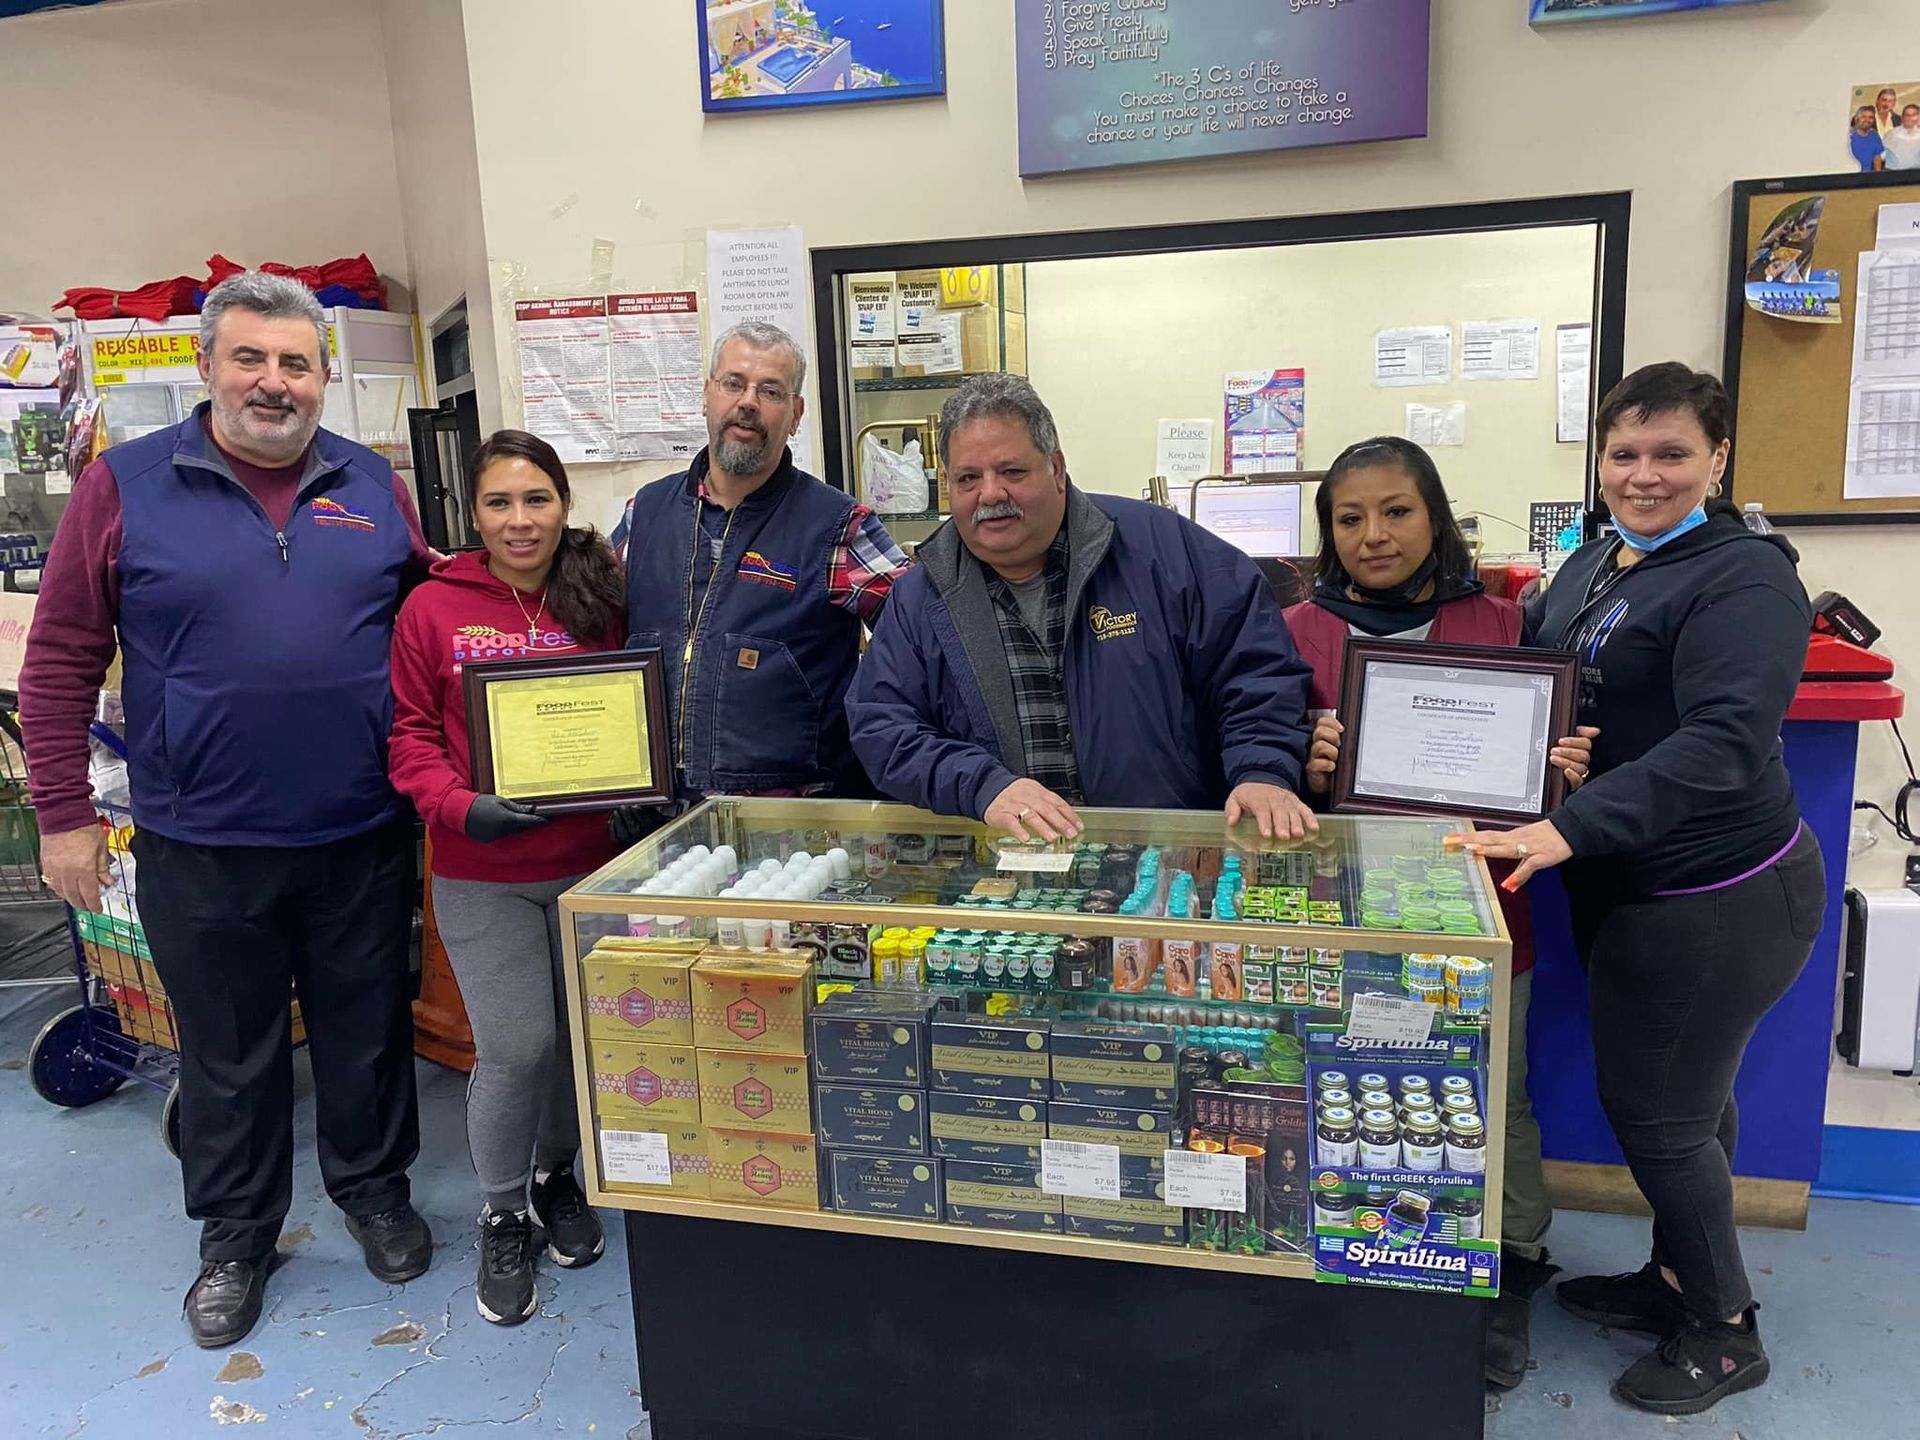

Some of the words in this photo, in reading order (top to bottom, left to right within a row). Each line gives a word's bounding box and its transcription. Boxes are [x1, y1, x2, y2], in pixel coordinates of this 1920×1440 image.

[1044, 1, 1055, 19] 2)
[1062, 1, 1111, 20] Forgive
[1044, 19, 1056, 36] 3)
[1062, 18, 1095, 33] Give
[1102, 11, 1142, 30] Freely
[1044, 35, 1057, 52] 4)
[1064, 31, 1105, 53] Speak
[1112, 24, 1169, 44] Truthfully
[1044, 52, 1057, 69] 5)
[1064, 51, 1095, 69] Pray
[1102, 42, 1159, 62] Faithfully
[1191, 67, 1201, 84] 3
[1208, 65, 1232, 83] C's
[1239, 62, 1256, 79] of
[1254, 77, 1318, 95] Changes
[1093, 110, 1118, 126] You
[1125, 110, 1155, 123] must
[1162, 103, 1199, 120] make
[1206, 105, 1216, 115] a
[1223, 98, 1268, 113] choice
[1277, 96, 1291, 108] to
[1298, 90, 1329, 105] take
[1336, 92, 1346, 103] a
[1087, 128, 1136, 143] chance
[1142, 127, 1157, 138] or
[1164, 124, 1193, 141] your
[1201, 117, 1219, 132] life
[1227, 114, 1245, 129] will
[1252, 114, 1290, 127] never
[1298, 107, 1354, 126] change.
[729, 243, 766, 251] ATTENTION
[731, 255, 768, 263] EMPLOYEES
[722, 269, 745, 277] PLEASE
[723, 281, 757, 289] ANYTHING
[757, 291, 775, 299] OPEN
[904, 290, 920, 299] SNAP
[922, 290, 932, 298] EBT
[858, 303, 874, 311] SNAP
[902, 299, 935, 307] Customers
[96, 337, 179, 356] REUSABLE
[1170, 427, 1204, 438] Please
[1168, 451, 1186, 461] Keep
[1188, 451, 1206, 460] Desk
[453, 633, 527, 651] FOOD
[454, 648, 528, 660] DEPOT
[1168, 945, 1189, 955] Caro
[1215, 948, 1236, 959] Caro
[663, 976, 678, 985] VIP
[778, 987, 794, 995] VIP
[979, 1031, 998, 1039] VIP
[839, 1039, 862, 1047] VITAL
[863, 1040, 891, 1048] HONEY
[1101, 1041, 1122, 1050] VIP
[670, 1056, 686, 1065] VIP
[784, 1067, 799, 1075] VIP
[976, 1100, 996, 1108] VIP
[844, 1107, 867, 1115] VITAL
[867, 1108, 894, 1117] HONEY
[1097, 1110, 1118, 1119] VIP
[682, 1133, 697, 1141] VIP
[792, 1145, 807, 1153] VIP
[992, 1167, 1012, 1175] VIP
[859, 1175, 882, 1183] VITAL
[883, 1176, 910, 1185] HONEY
[1046, 1172, 1065, 1180] Each
[1351, 1172, 1368, 1181] The
[1371, 1173, 1390, 1182] first
[1393, 1174, 1425, 1183] GREEK
[1428, 1175, 1473, 1186] Spirulina
[1346, 1242, 1466, 1272] Spirulina
[1366, 1278, 1390, 1286] Natural,
[1390, 1280, 1417, 1289] Organic,
[1417, 1283, 1436, 1291] Greek
[1436, 1285, 1462, 1293] Product
